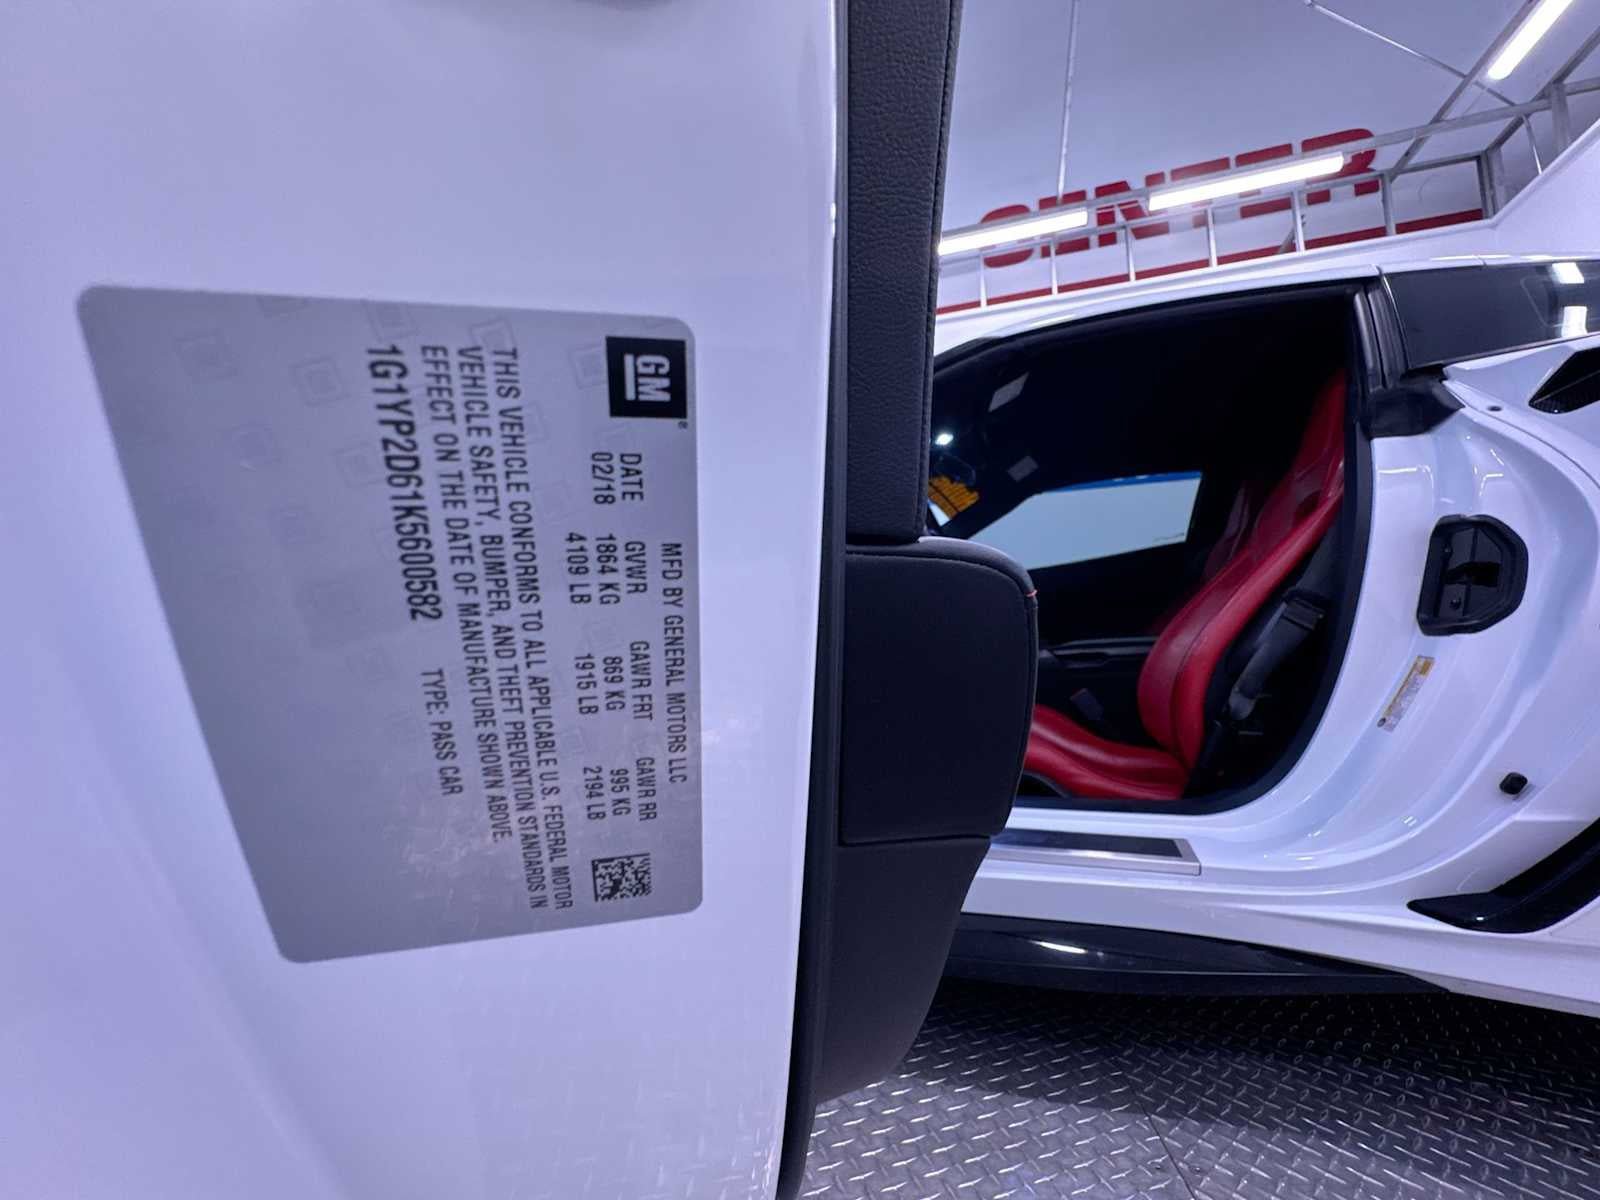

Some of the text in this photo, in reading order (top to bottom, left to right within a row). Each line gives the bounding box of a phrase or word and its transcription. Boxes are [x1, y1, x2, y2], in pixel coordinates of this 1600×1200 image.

[636, 354, 672, 402] GM
[367, 344, 443, 620] 1G1YP2D61K5600582
[591, 452, 616, 505] 02/18
[619, 453, 644, 501] DATE
[420, 345, 512, 843] EFFECT ON THE DATE OF MANUFACTURE SHOWN ABOVE.
[565, 532, 592, 604] 4109 LB
[595, 533, 621, 605] 1864 KG
[624, 541, 648, 594] GVWR
[457, 346, 549, 910] VEHICLE SAFETY, BUMPER, AND THEFT PREVENTION STANDARDS IN
[493, 347, 573, 910] THIS VEHICLE CONFORMS TO ALL APPLICABLE U.S. FEDERAL MOTOR
[574, 653, 599, 715] 1915 LB
[603, 656, 626, 711] 869 KG
[629, 640, 653, 721] GAWR FRT
[661, 543, 687, 784] MFD BY GENERAL MOTORS LLC
[420, 668, 463, 795] TYPE: PASS CAR
[583, 766, 606, 820] 2194 LB
[610, 768, 631, 816] 995 KG
[636, 757, 657, 821] GAWR RR
